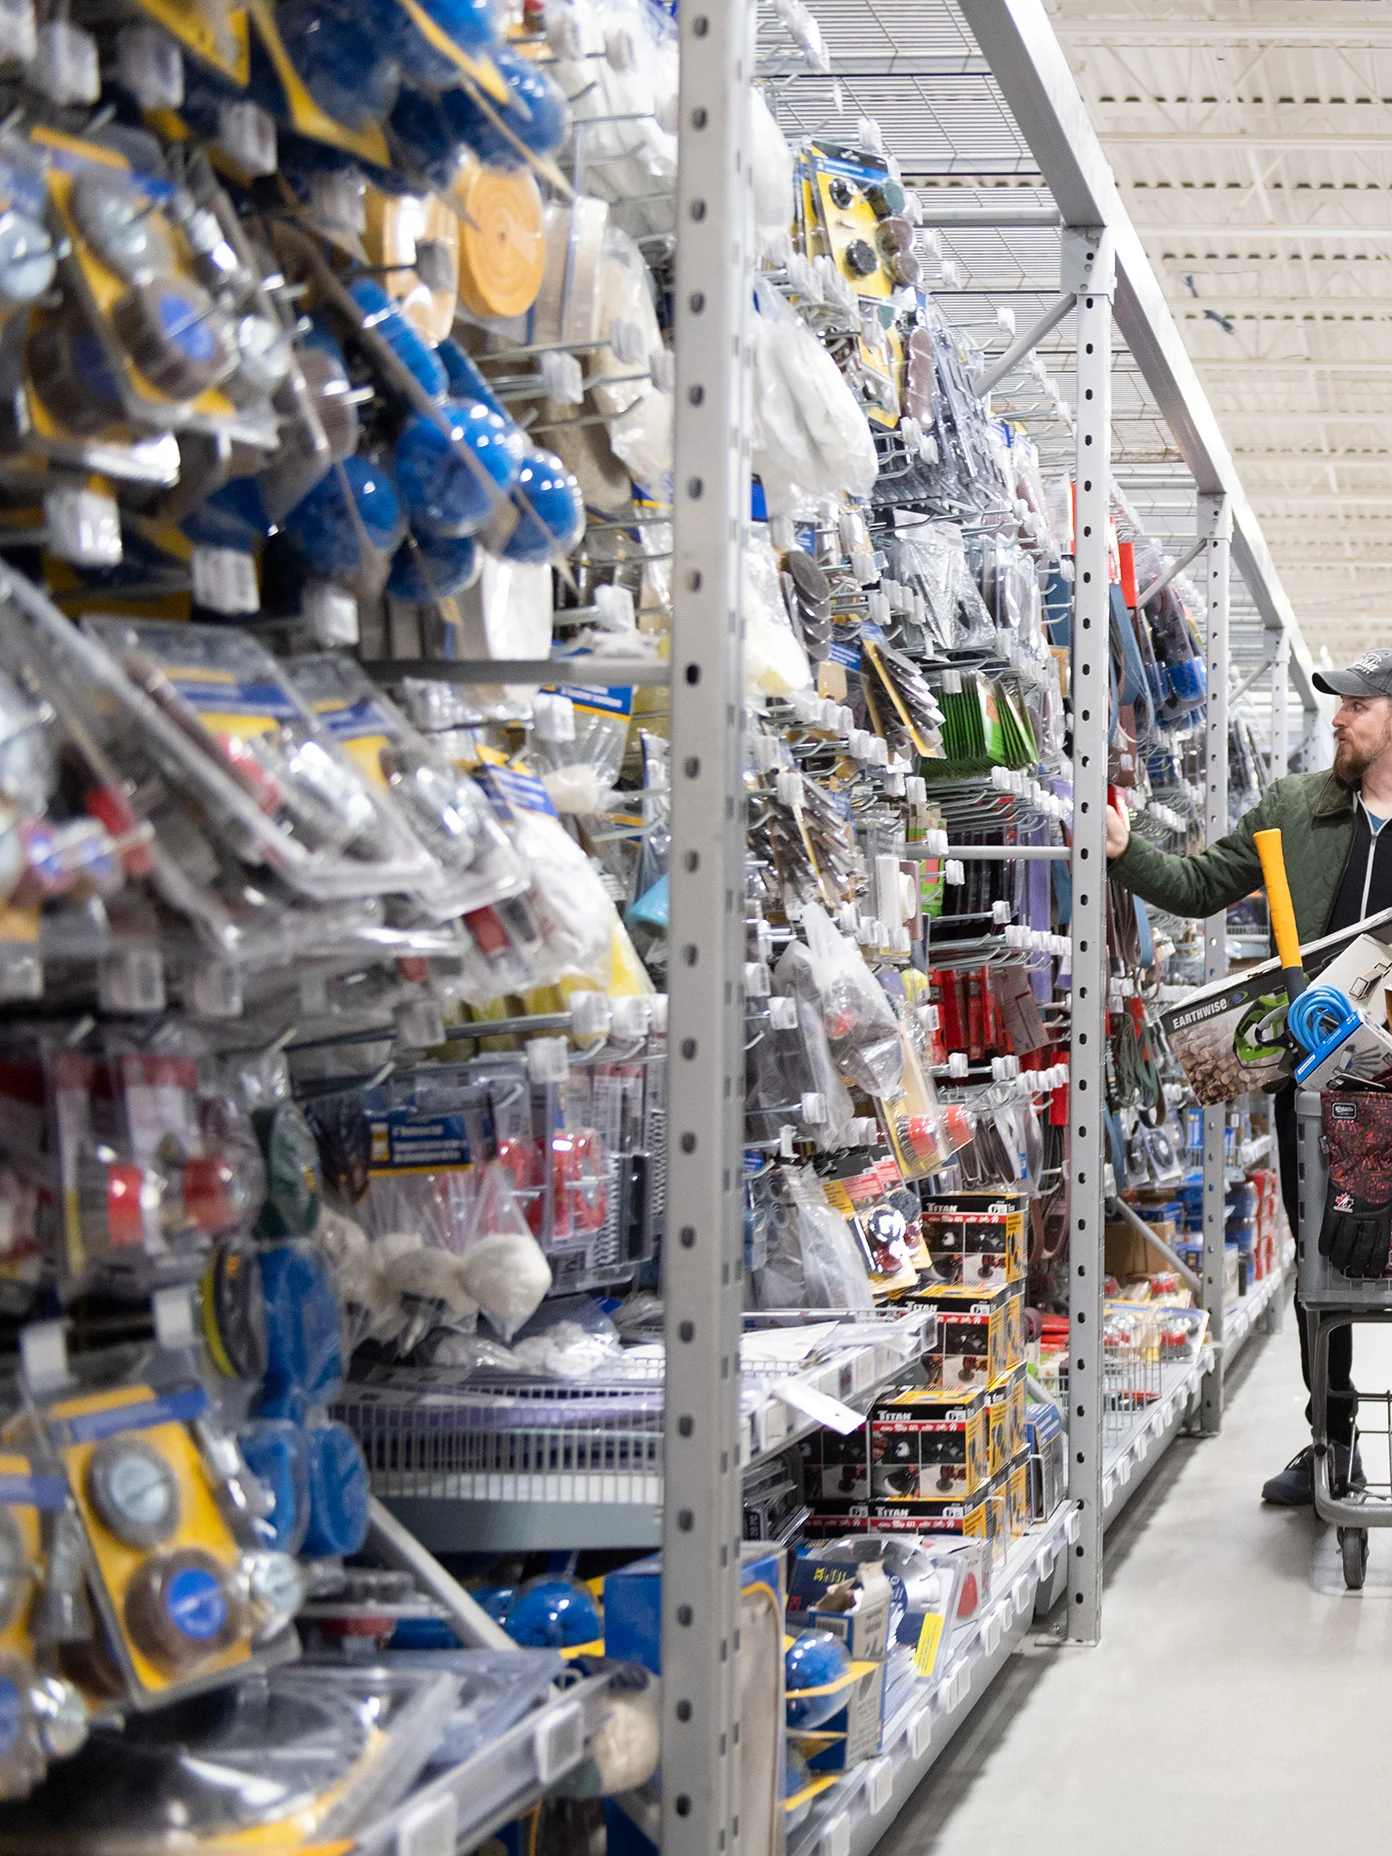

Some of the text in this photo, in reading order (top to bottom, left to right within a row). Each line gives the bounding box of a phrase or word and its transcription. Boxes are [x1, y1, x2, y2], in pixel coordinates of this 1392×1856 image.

[926, 1202, 959, 1213] TITAN
[905, 1300, 939, 1313] TITAN
[877, 1410, 912, 1420] TITAN
[875, 1506, 911, 1518] TITAN
